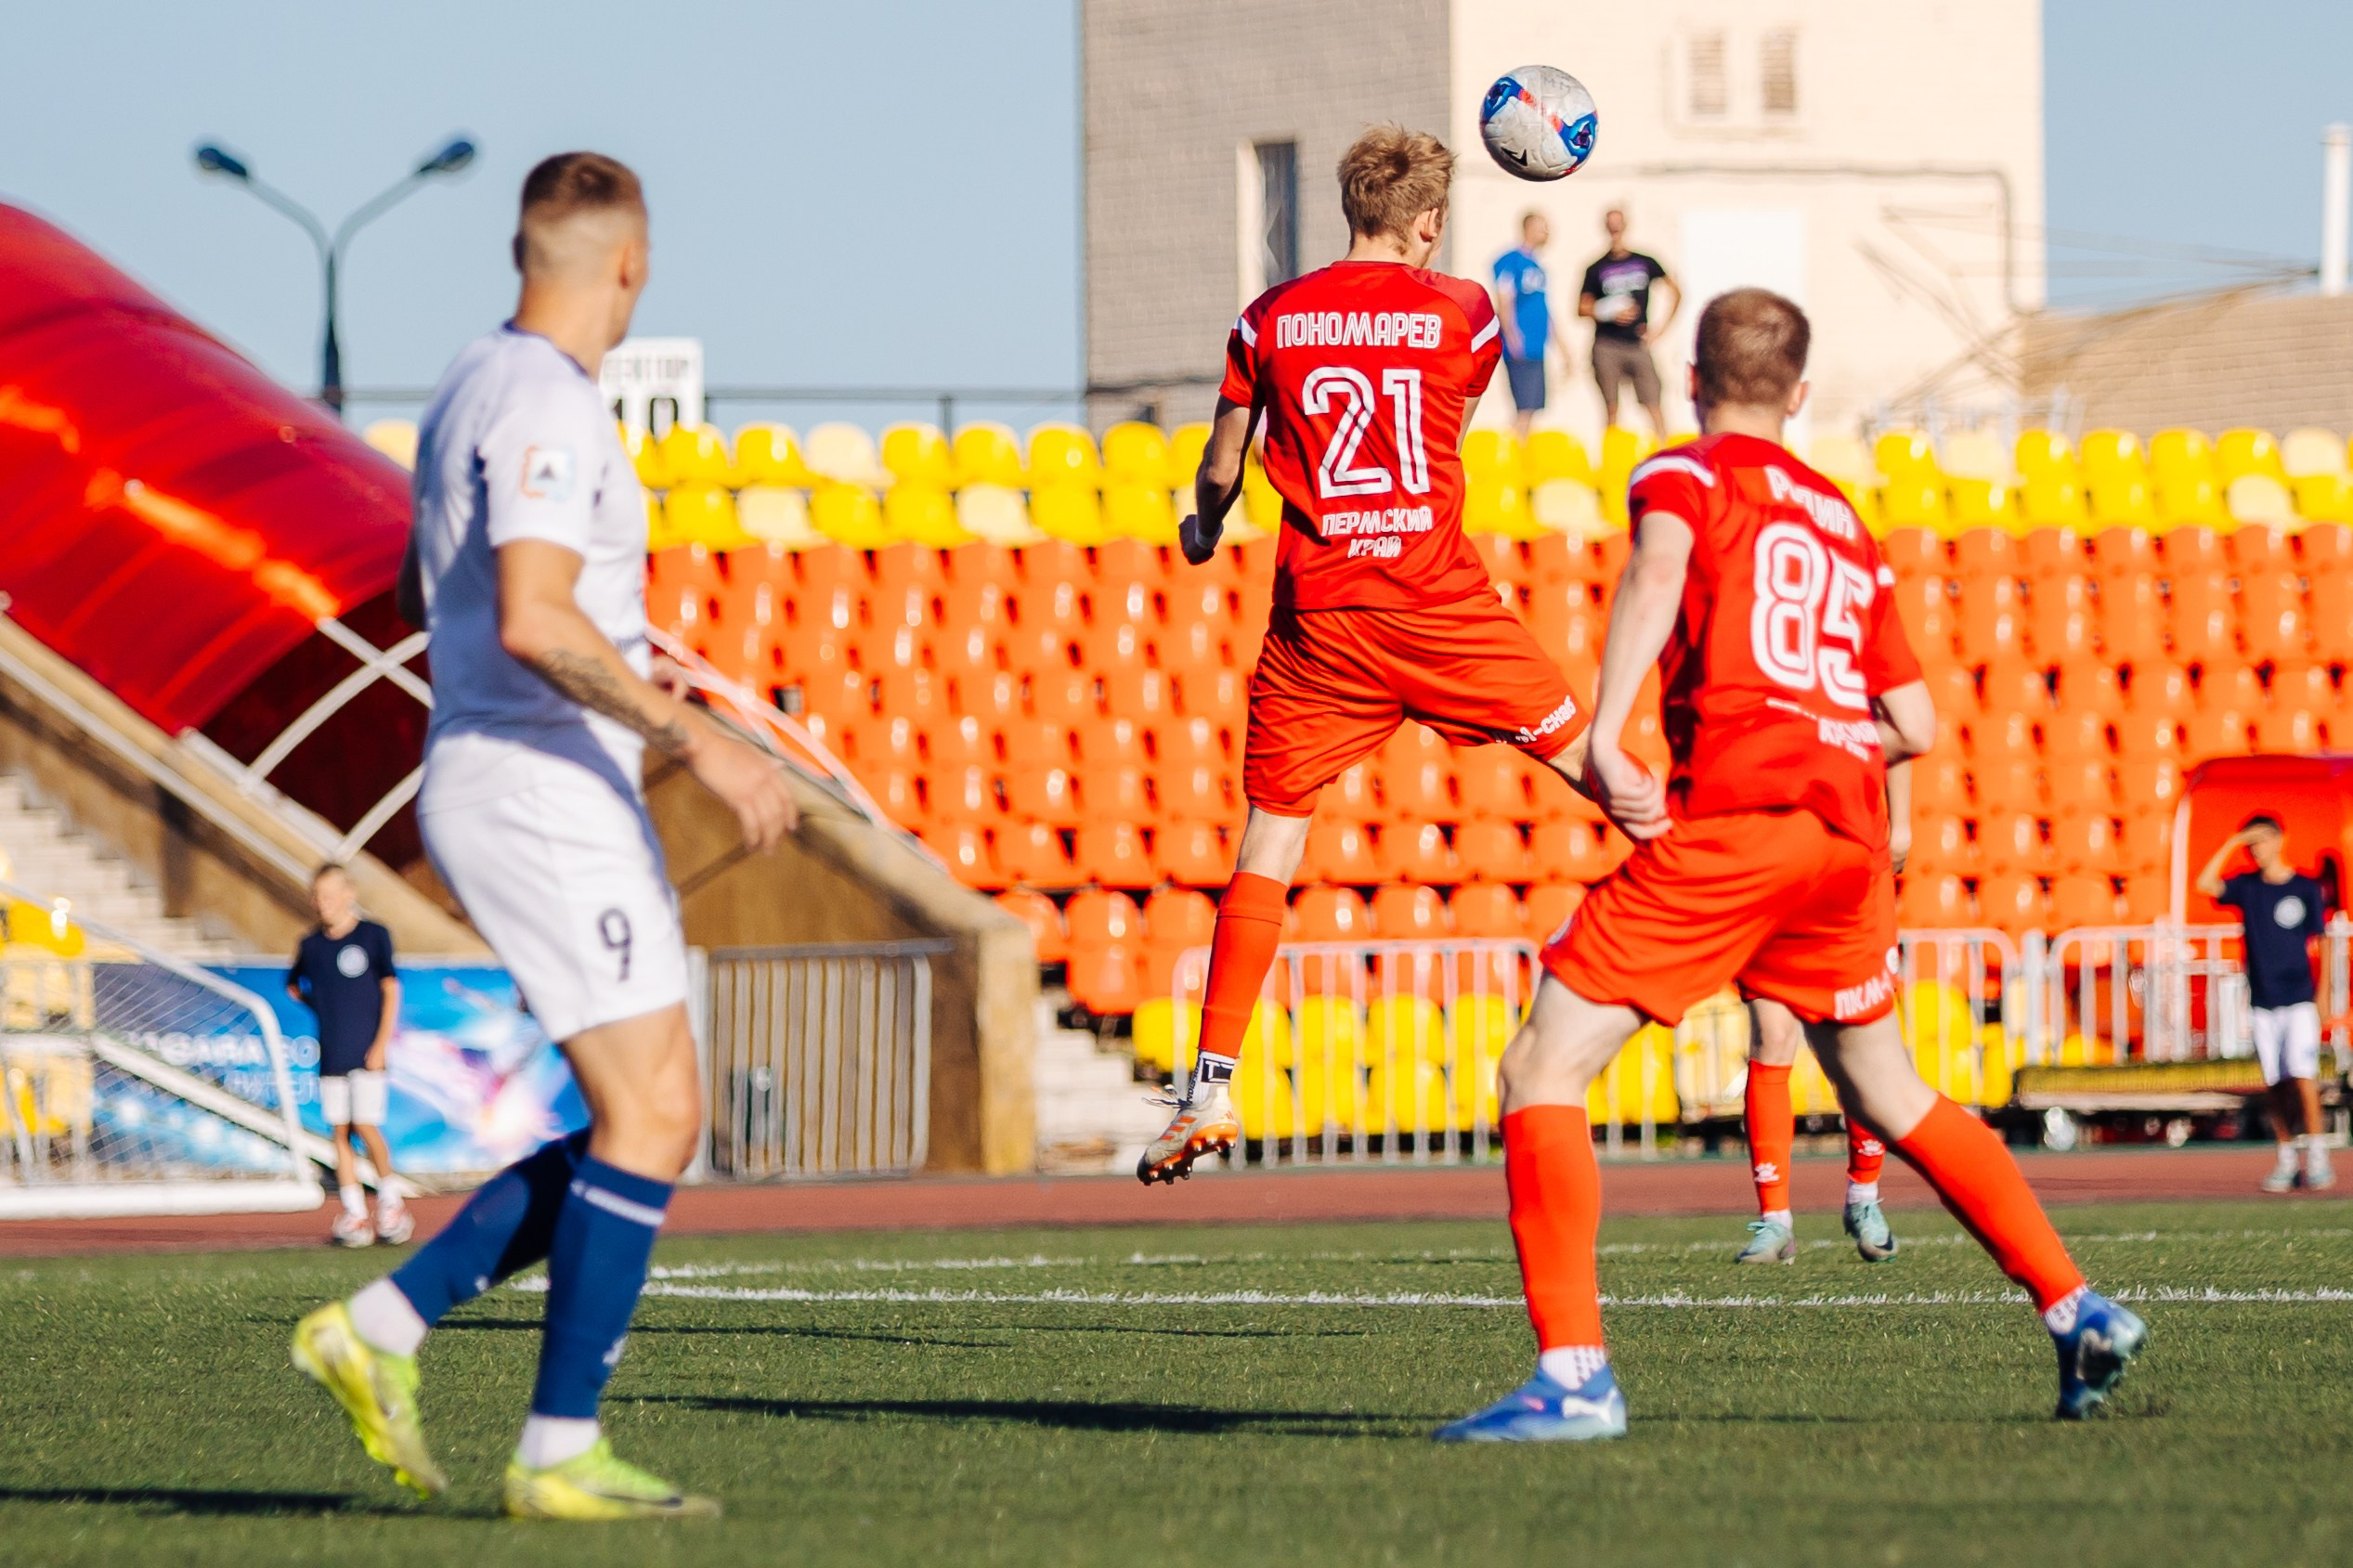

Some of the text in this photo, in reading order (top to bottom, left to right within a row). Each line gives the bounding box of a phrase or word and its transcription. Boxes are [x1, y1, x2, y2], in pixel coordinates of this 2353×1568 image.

[1276, 311, 1442, 349] ПОНОМАРЕВ
[1302, 366, 1431, 499] 21
[1320, 506, 1433, 538] ПЕРМСКИЙ
[1347, 536, 1402, 559] КРАЙ
[1750, 523, 1874, 711] 85
[597, 906, 632, 982] 9
